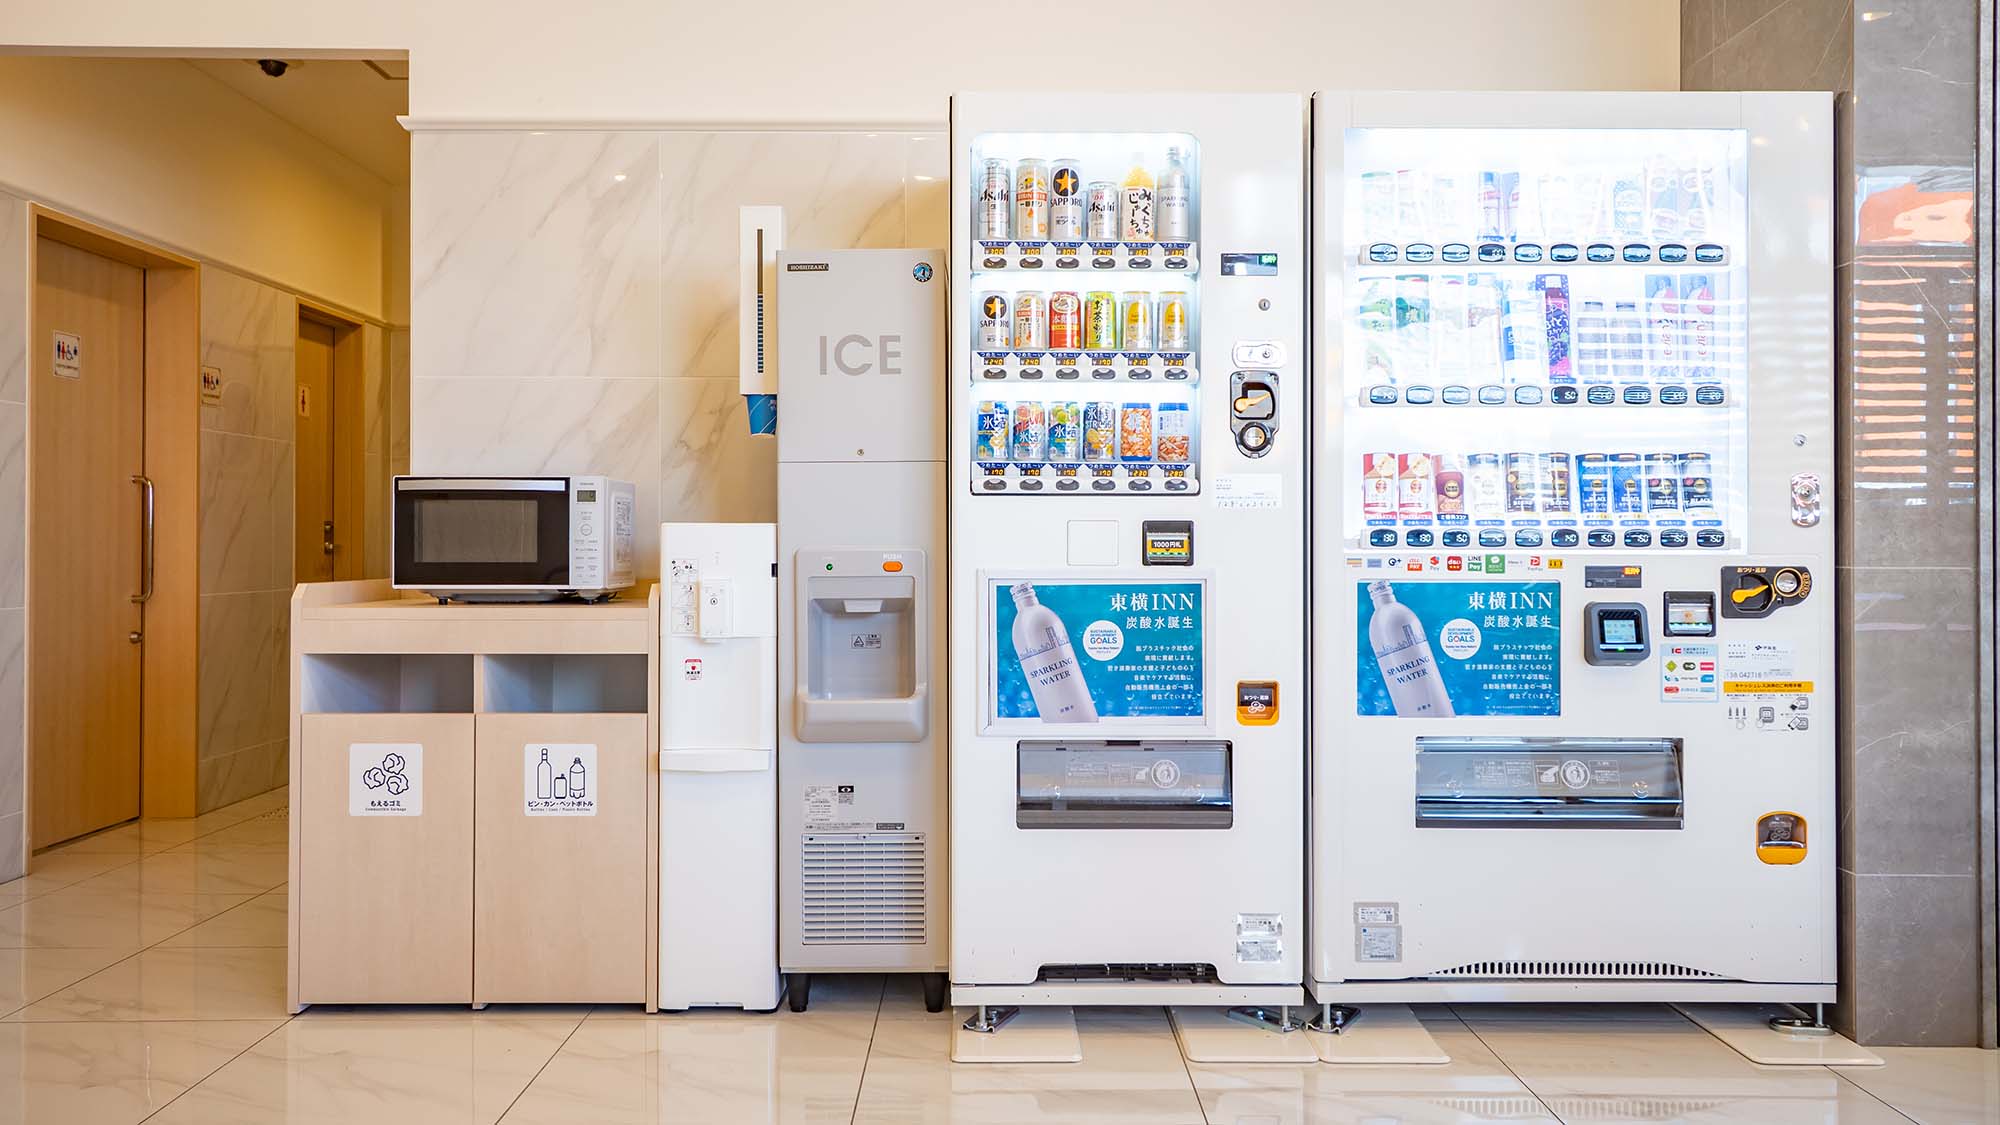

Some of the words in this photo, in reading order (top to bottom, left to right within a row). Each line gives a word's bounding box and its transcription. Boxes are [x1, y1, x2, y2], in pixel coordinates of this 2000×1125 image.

[820, 334, 902, 376] ICE
[1110, 593, 1194, 612] 東横INN
[1467, 592, 1553, 610] 東横INN
[1126, 616, 1194, 629] 炭酸水誕生
[1484, 615, 1552, 628] 炭酸水誕生
[1030, 658, 1073, 678] SPARKLING
[1387, 656, 1430, 675] SPARKLING
[1040, 670, 1071, 686] WATER
[1397, 668, 1428, 684] WATER
